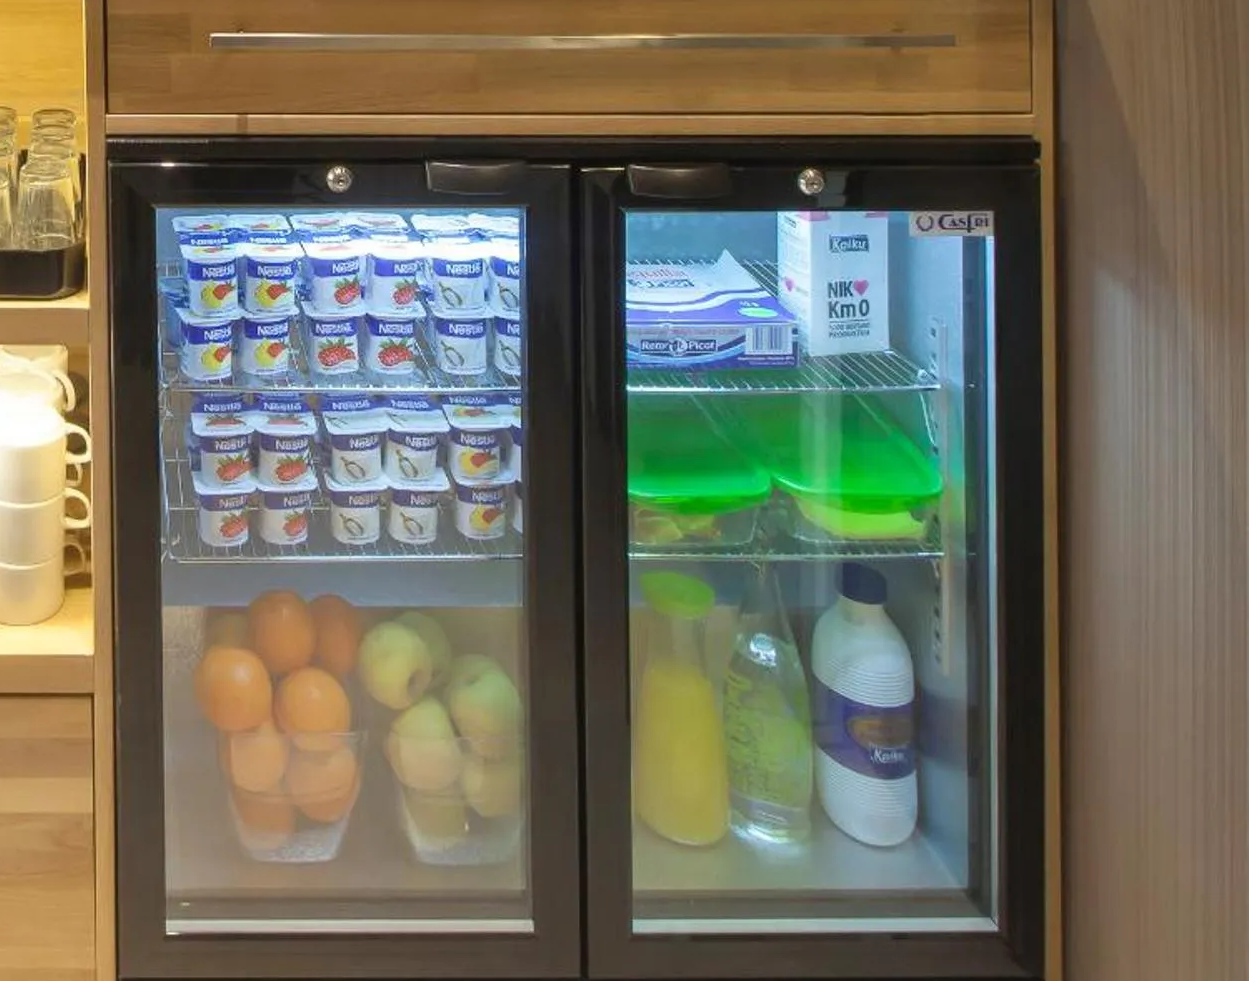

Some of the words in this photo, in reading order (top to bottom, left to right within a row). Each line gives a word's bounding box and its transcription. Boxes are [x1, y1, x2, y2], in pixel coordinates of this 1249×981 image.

[828, 281, 854, 298] NIK
[828, 301, 856, 318] Km
[859, 299, 870, 317] 0
